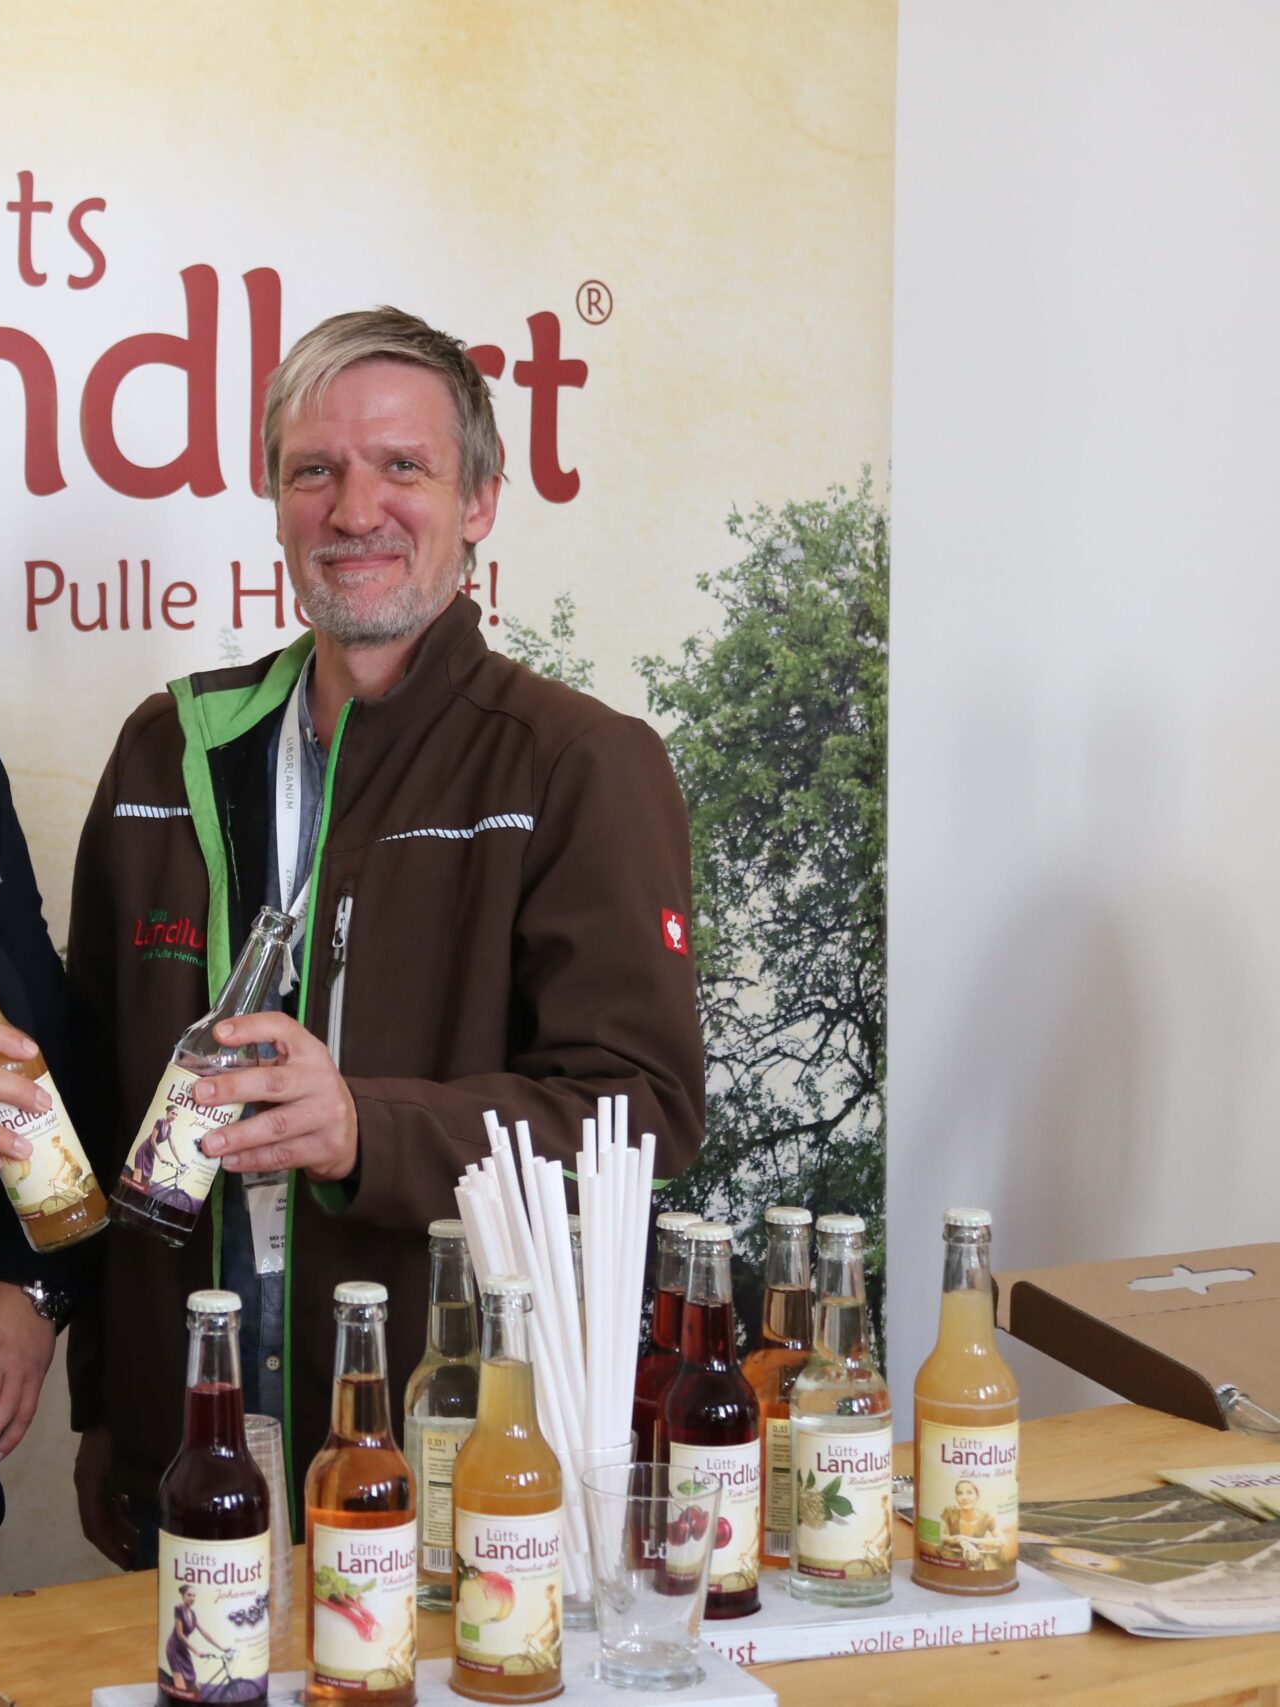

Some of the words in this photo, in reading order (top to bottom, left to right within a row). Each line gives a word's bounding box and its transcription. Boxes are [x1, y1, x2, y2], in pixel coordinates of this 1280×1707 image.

[26, 559, 198, 635] Pulle
[284, 737, 295, 810] LIBORIANUM
[828, 1445, 859, 1457] Lütts
[941, 1443, 1017, 1466] Landlust
[952, 1437, 984, 1450] Lütts
[706, 1458, 736, 1471] Lütts
[816, 1451, 891, 1474] Landlust
[486, 1528, 520, 1543] Lütts
[184, 1551, 217, 1566] Lütts
[350, 1543, 384, 1556] Lütts
[474, 1535, 560, 1560] Landlust
[174, 1558, 262, 1585] Landlust
[912, 1626, 963, 1649] Pulle
[971, 1616, 1056, 1644] Heimat!
